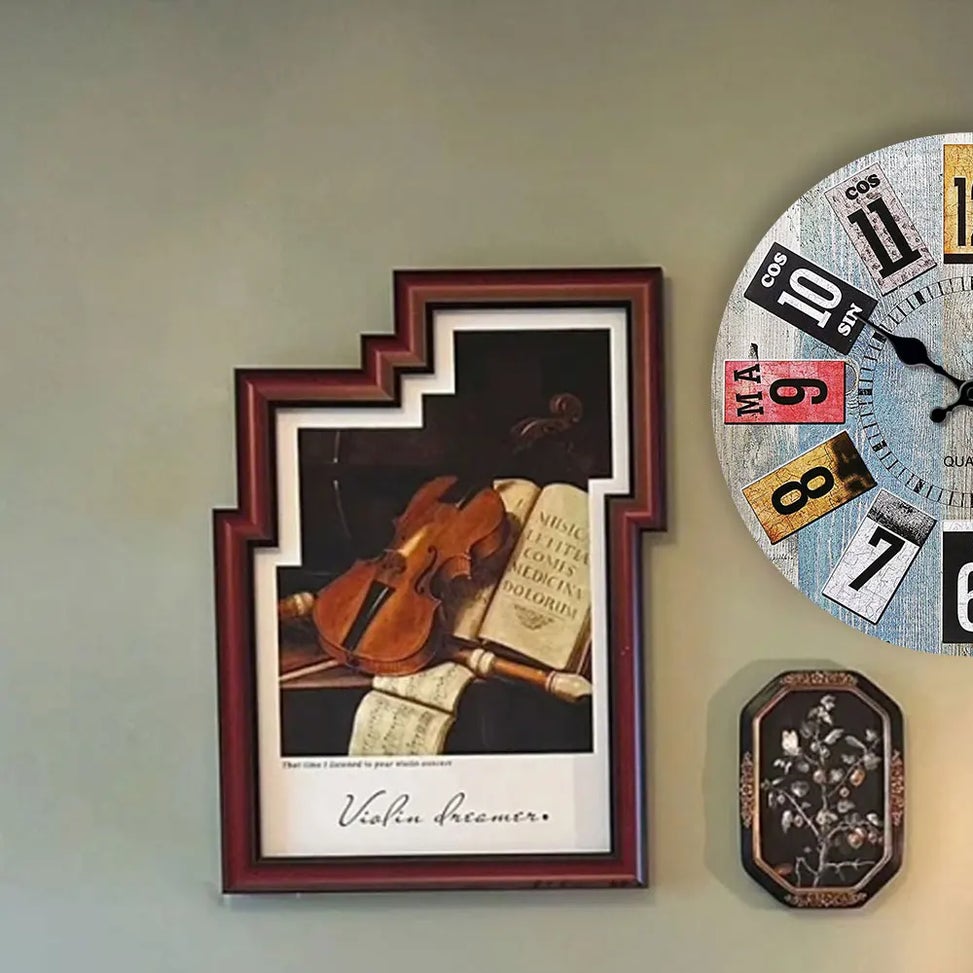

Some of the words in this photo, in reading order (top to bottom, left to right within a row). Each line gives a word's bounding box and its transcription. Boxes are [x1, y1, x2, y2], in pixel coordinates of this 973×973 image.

[845, 173, 881, 200] COS
[847, 197, 921, 279] 11
[761, 252, 788, 288] COS
[777, 268, 842, 328] 10
[838, 303, 863, 337] SIN
[770, 378, 828, 405] 9
[771, 465, 834, 515] 8
[848, 526, 905, 591] 7
[338, 789, 422, 827] Violin
